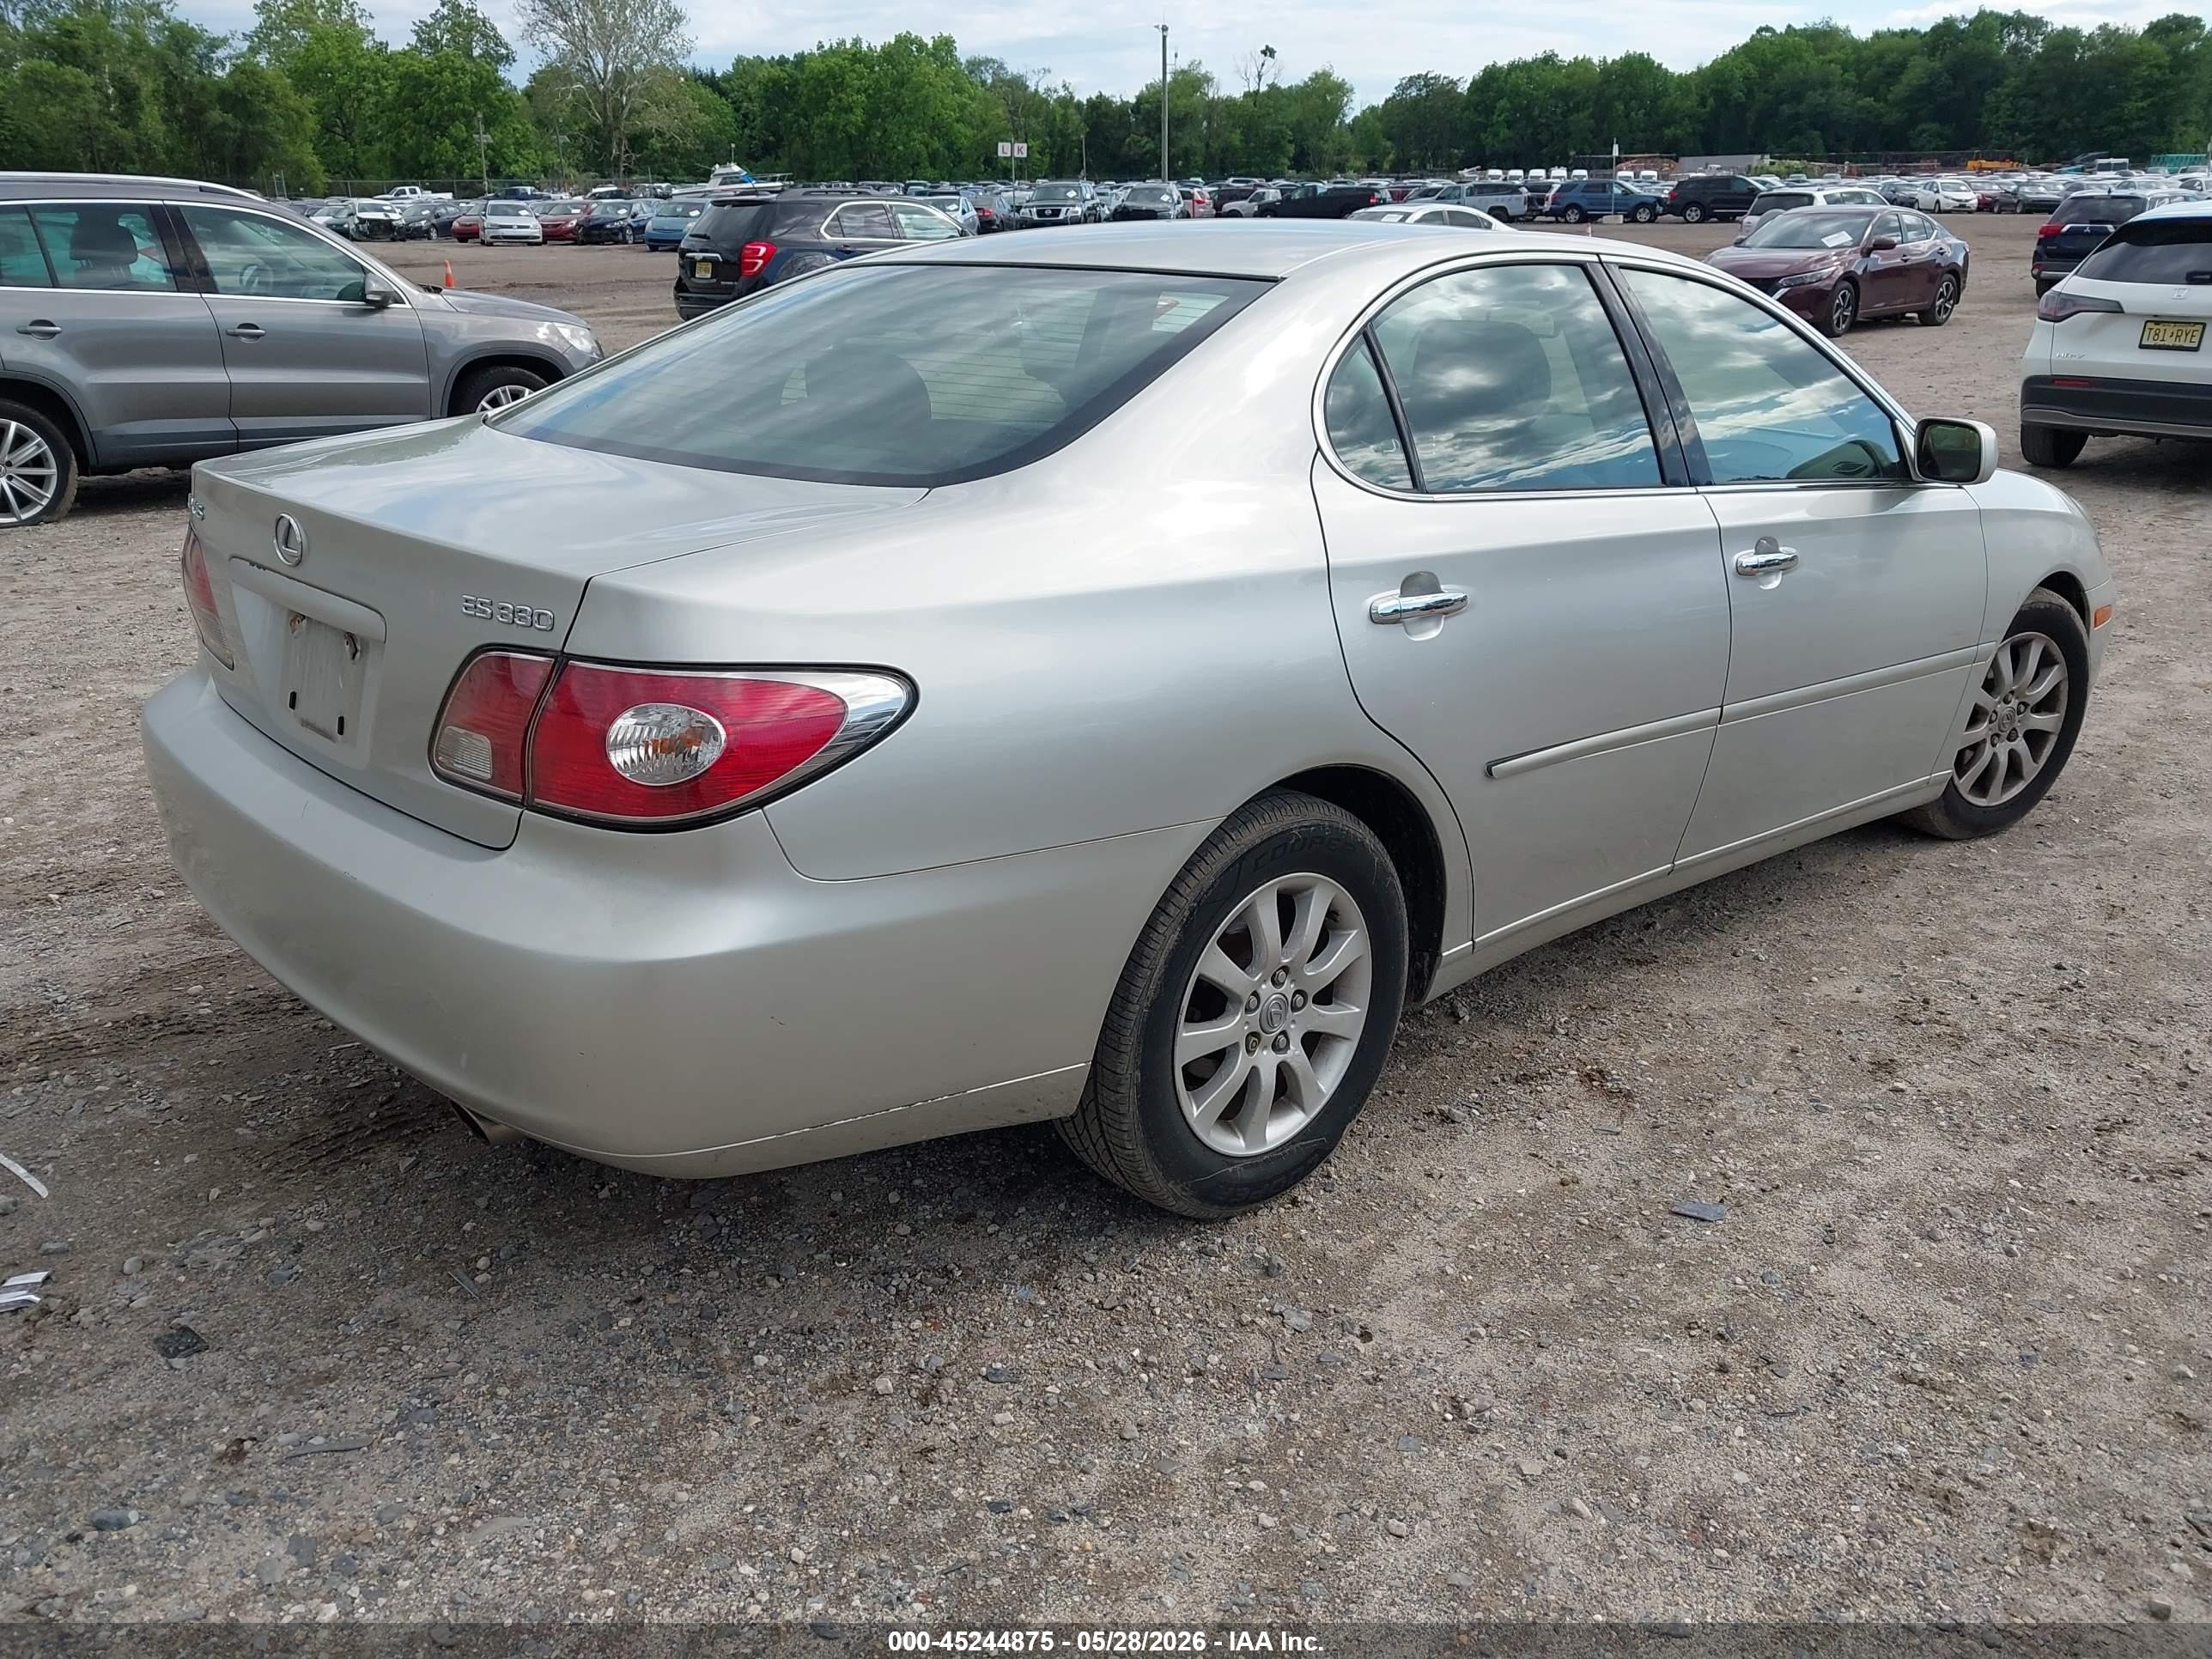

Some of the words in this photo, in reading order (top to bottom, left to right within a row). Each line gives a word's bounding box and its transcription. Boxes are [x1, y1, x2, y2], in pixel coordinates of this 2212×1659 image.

[1001, 143, 1010, 155] L
[1017, 144, 1024, 155] K
[2146, 327, 2167, 342] T81
[2174, 328, 2200, 343] RYE
[461, 593, 494, 620] ES
[495, 601, 555, 632] 330
